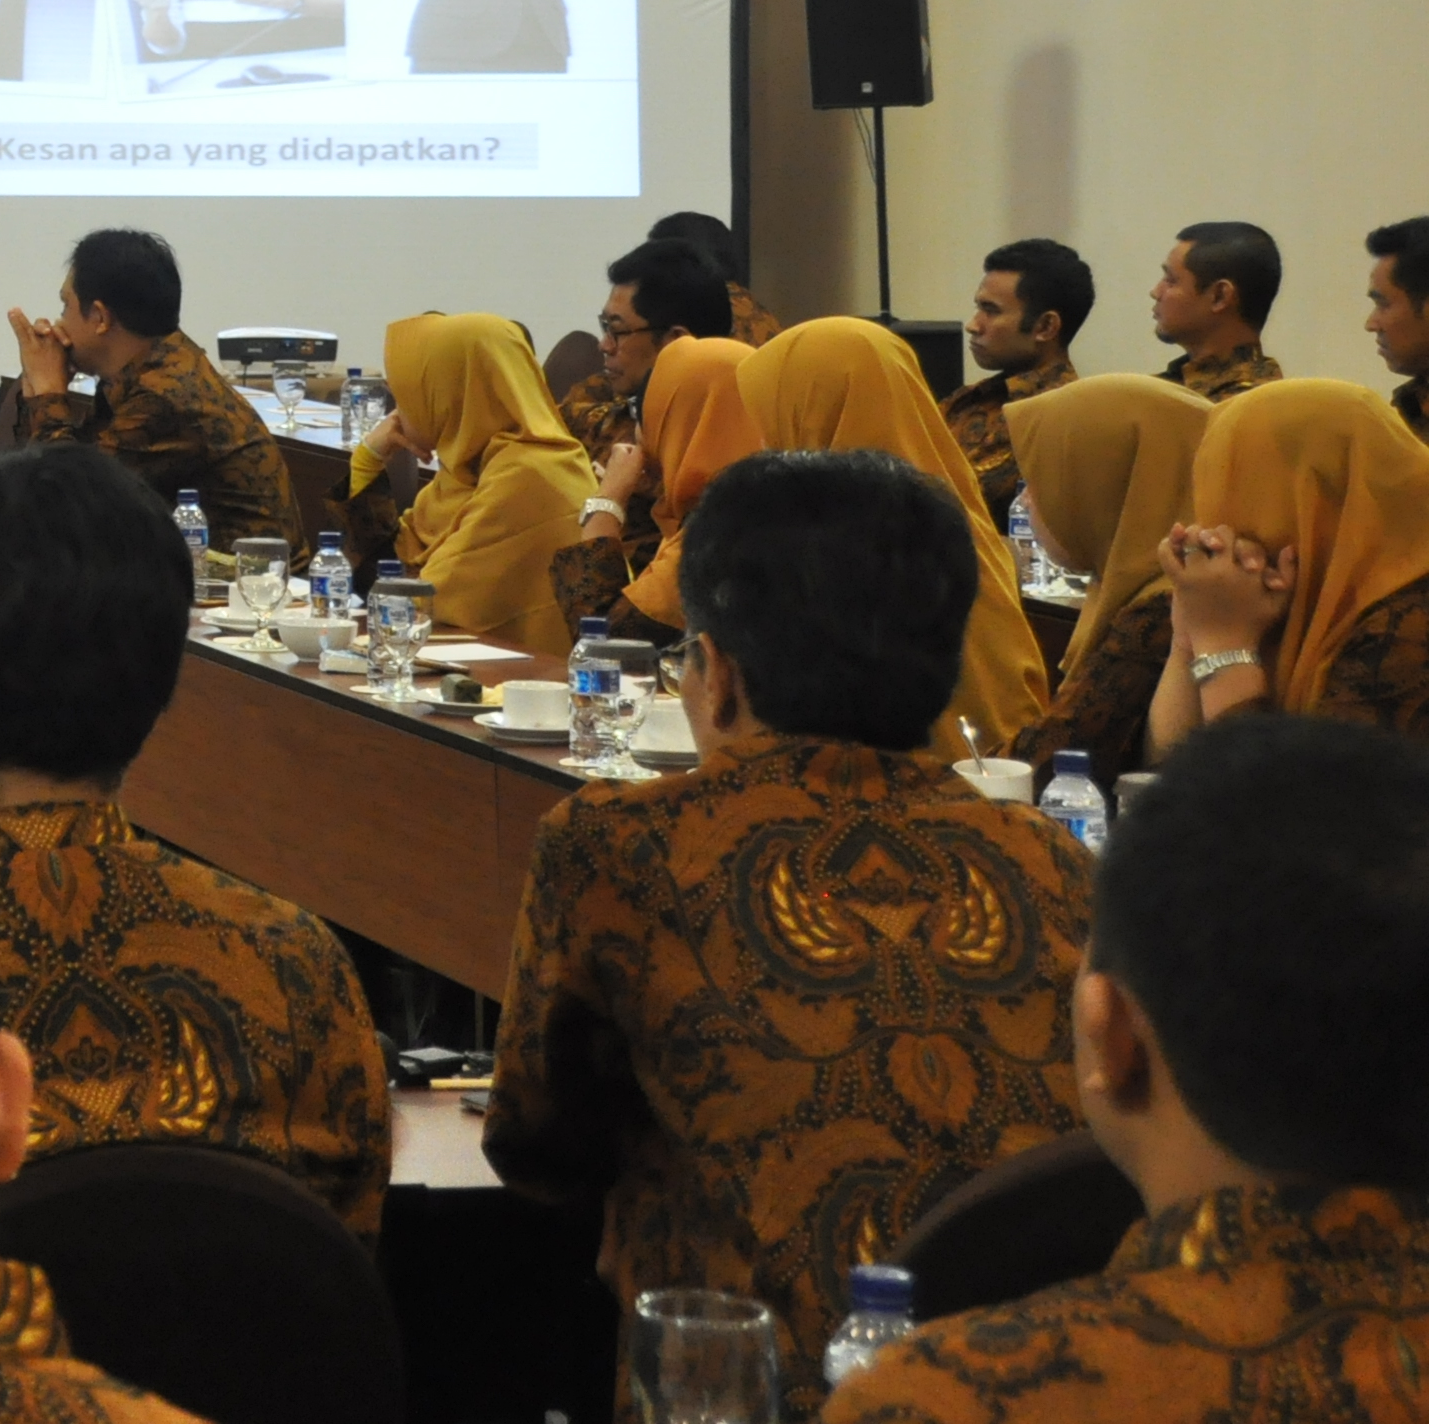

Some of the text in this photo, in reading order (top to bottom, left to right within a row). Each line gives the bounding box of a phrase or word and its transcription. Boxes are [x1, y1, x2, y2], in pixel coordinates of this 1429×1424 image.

[109, 143, 172, 167] apa
[183, 143, 268, 167] yang
[278, 136, 501, 167] didapatkan?
